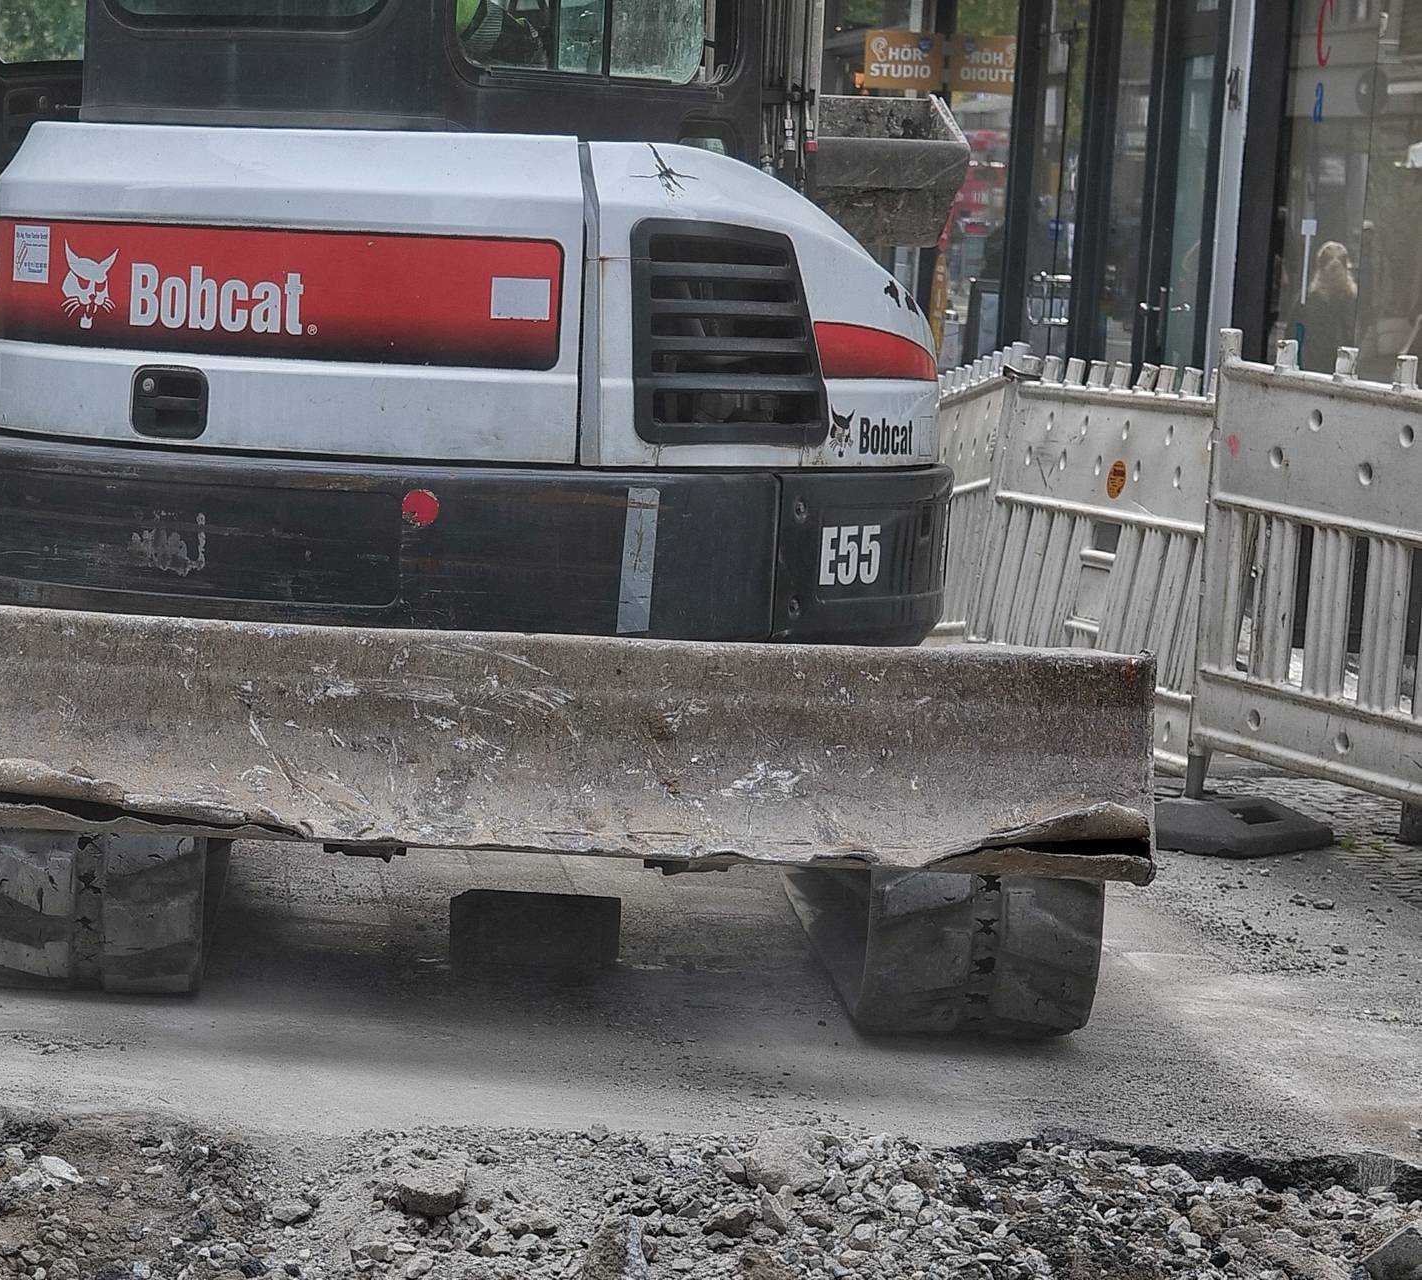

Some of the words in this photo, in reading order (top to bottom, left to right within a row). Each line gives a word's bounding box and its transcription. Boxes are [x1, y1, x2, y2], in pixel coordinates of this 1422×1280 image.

[869, 63, 931, 79] STUDIO
[888, 44, 929, 61] HÖR-
[129, 262, 305, 336] Bobcat
[858, 417, 913, 455] Bobcat
[818, 524, 881, 586] E55
